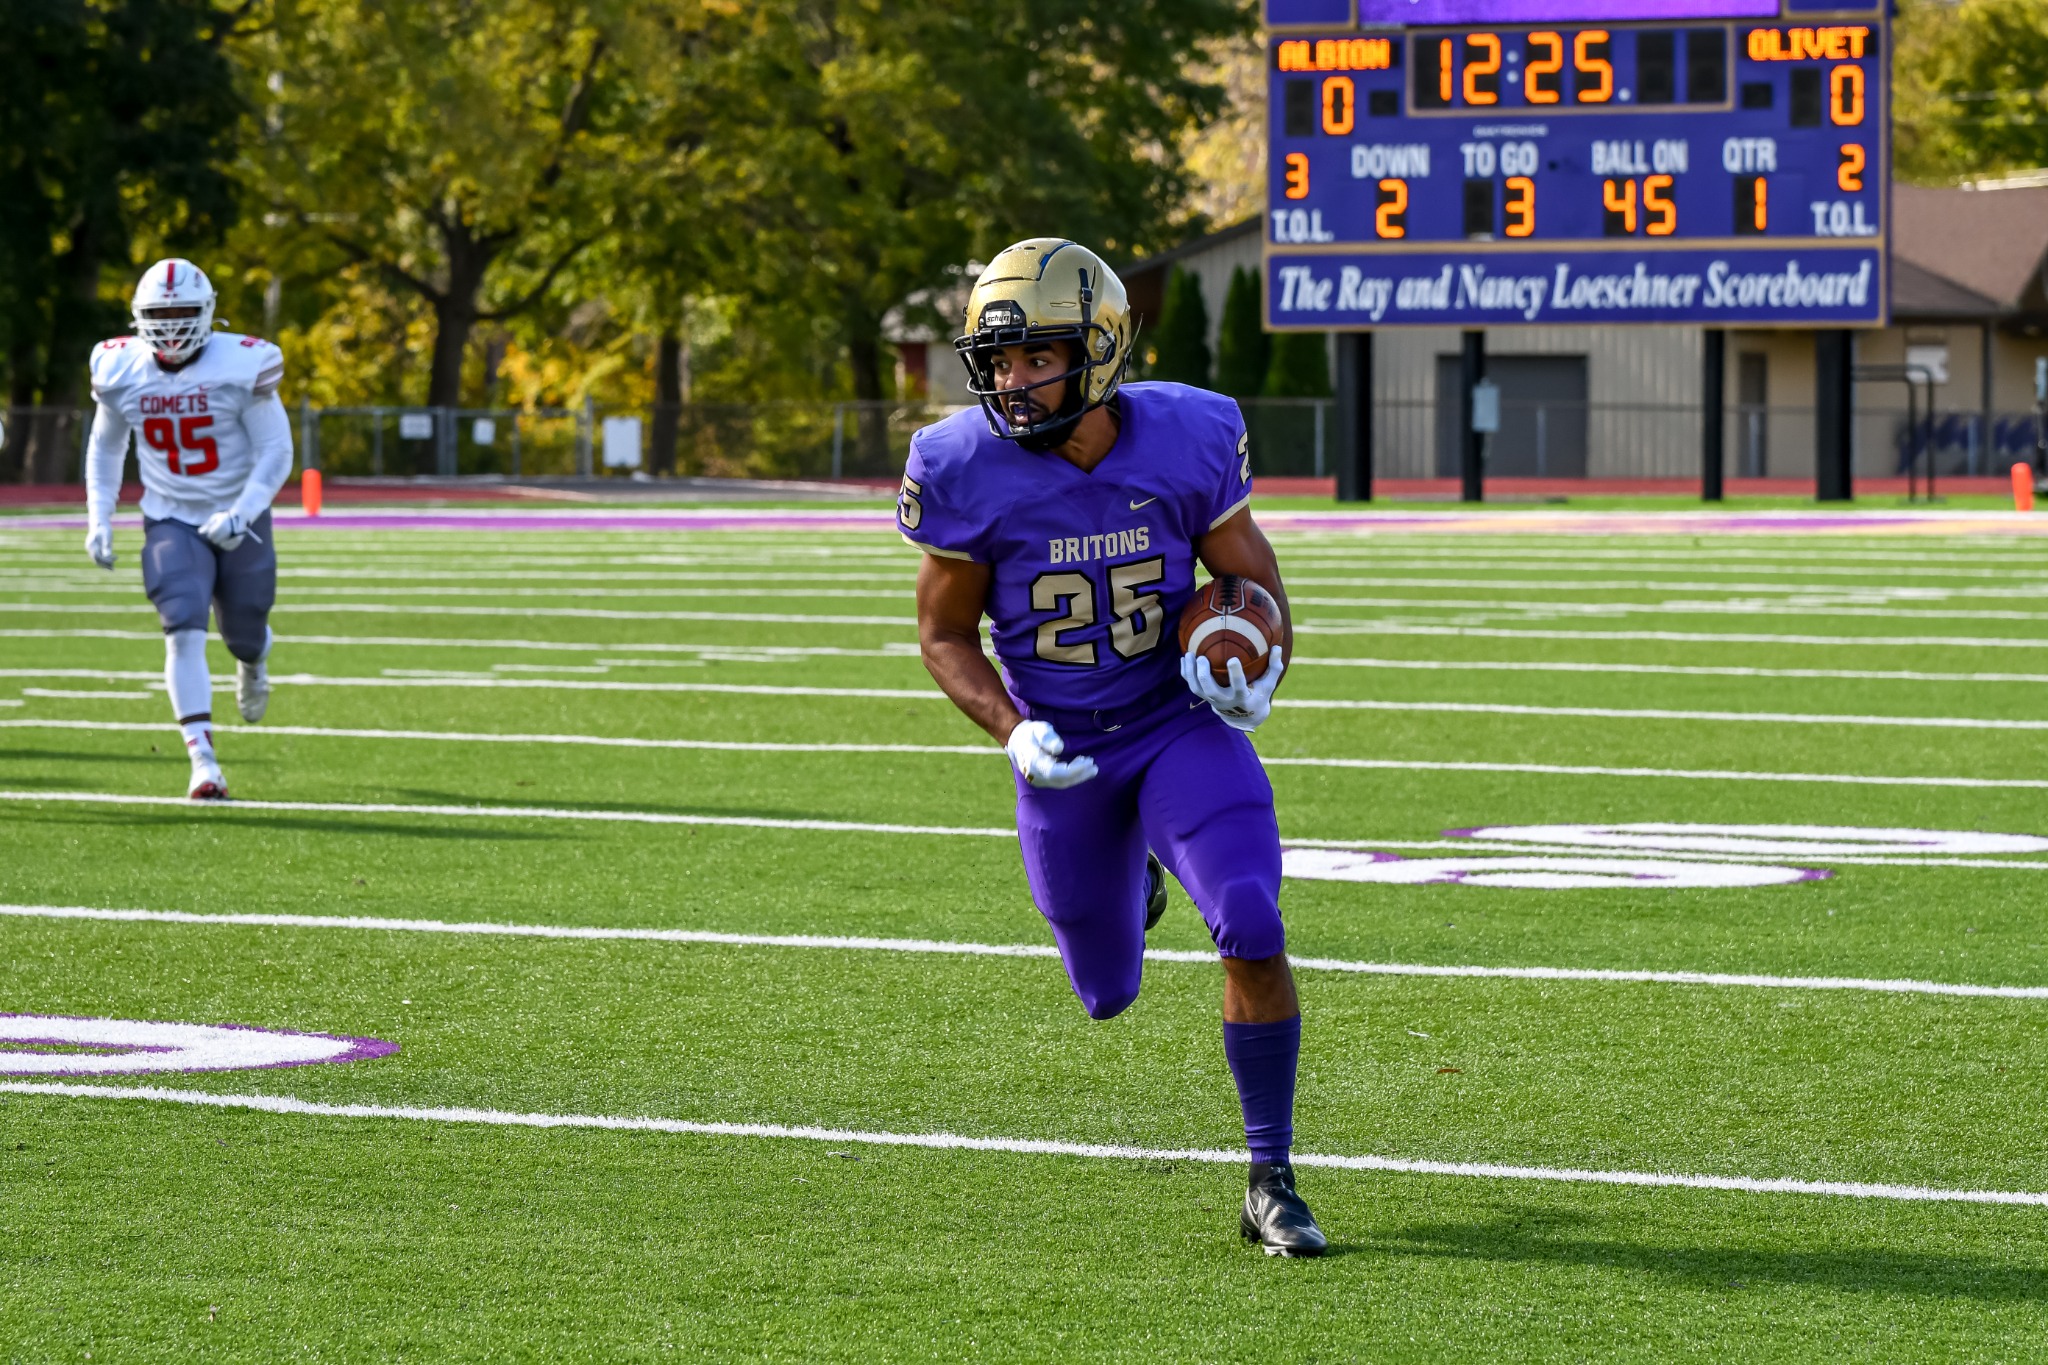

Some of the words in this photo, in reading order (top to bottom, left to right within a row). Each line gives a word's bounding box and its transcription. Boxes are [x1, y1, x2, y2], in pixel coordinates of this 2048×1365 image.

[1279, 38, 1390, 72] ALBION
[1748, 26, 1869, 61] OLIVET
[1322, 76, 1354, 135] 0
[1830, 64, 1864, 126] 0
[1285, 153, 1309, 199] 3
[1351, 144, 1431, 179] DOWN
[1460, 141, 1497, 178] TO
[1500, 141, 1539, 178] GO
[1590, 140, 1649, 175] BALL
[1652, 139, 1689, 174] ON
[1722, 137, 1777, 172] QTR
[1837, 143, 1865, 191] 2
[1272, 208, 1334, 242] T.O.L.
[1376, 179, 1408, 238] 2
[1505, 176, 1535, 237] 3
[1603, 174, 1676, 235] 45
[1754, 176, 1767, 231] 1
[1810, 200, 1876, 237] T.O.L.
[1279, 264, 1333, 311] The
[1335, 264, 1393, 322] Ray
[1395, 263, 1453, 310] and
[1454, 263, 1548, 321] Nancy
[1550, 260, 1701, 311] Loeschner
[1702, 258, 1872, 308] Scoreboard
[140, 393, 209, 414] COMETS
[143, 415, 219, 477] 95
[897, 472, 922, 531] 5
[1049, 526, 1150, 564] BRITONS
[1030, 553, 1166, 668] 25
